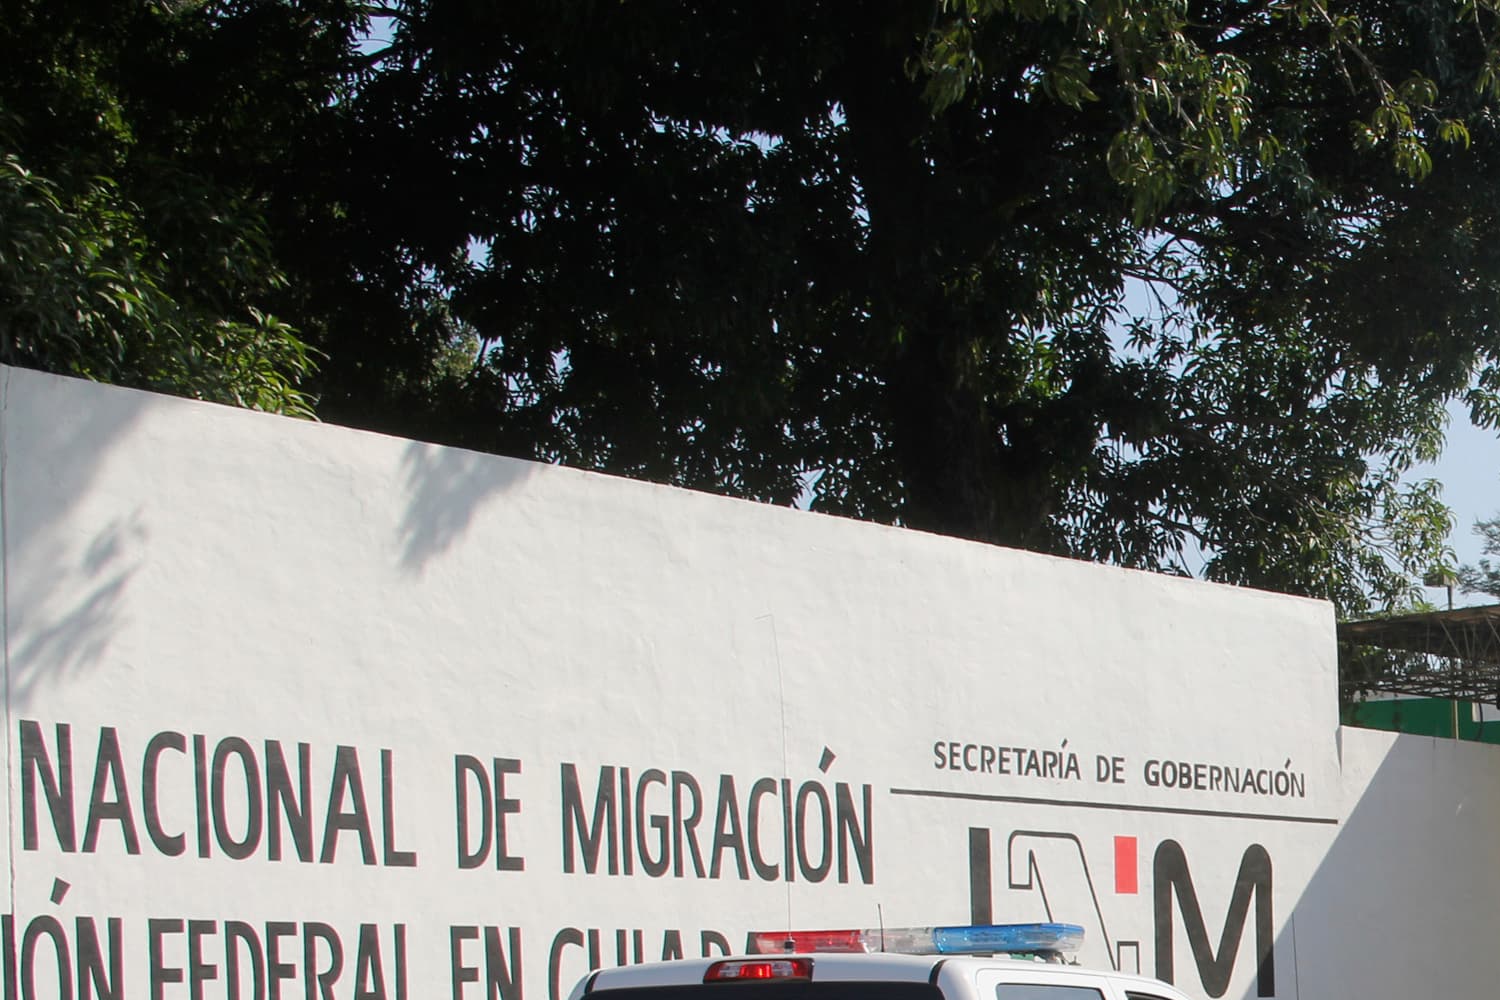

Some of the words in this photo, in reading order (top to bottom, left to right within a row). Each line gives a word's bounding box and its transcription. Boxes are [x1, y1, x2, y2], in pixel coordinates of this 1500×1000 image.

[20, 720, 417, 867] NACIONAL
[455, 754, 524, 871] DE
[560, 746, 873, 886] MIGRACIÓN
[934, 738, 1081, 780] SECRETARÍA
[1096, 755, 1125, 784] DE
[1144, 758, 1305, 797] GOBERNACIÓN
